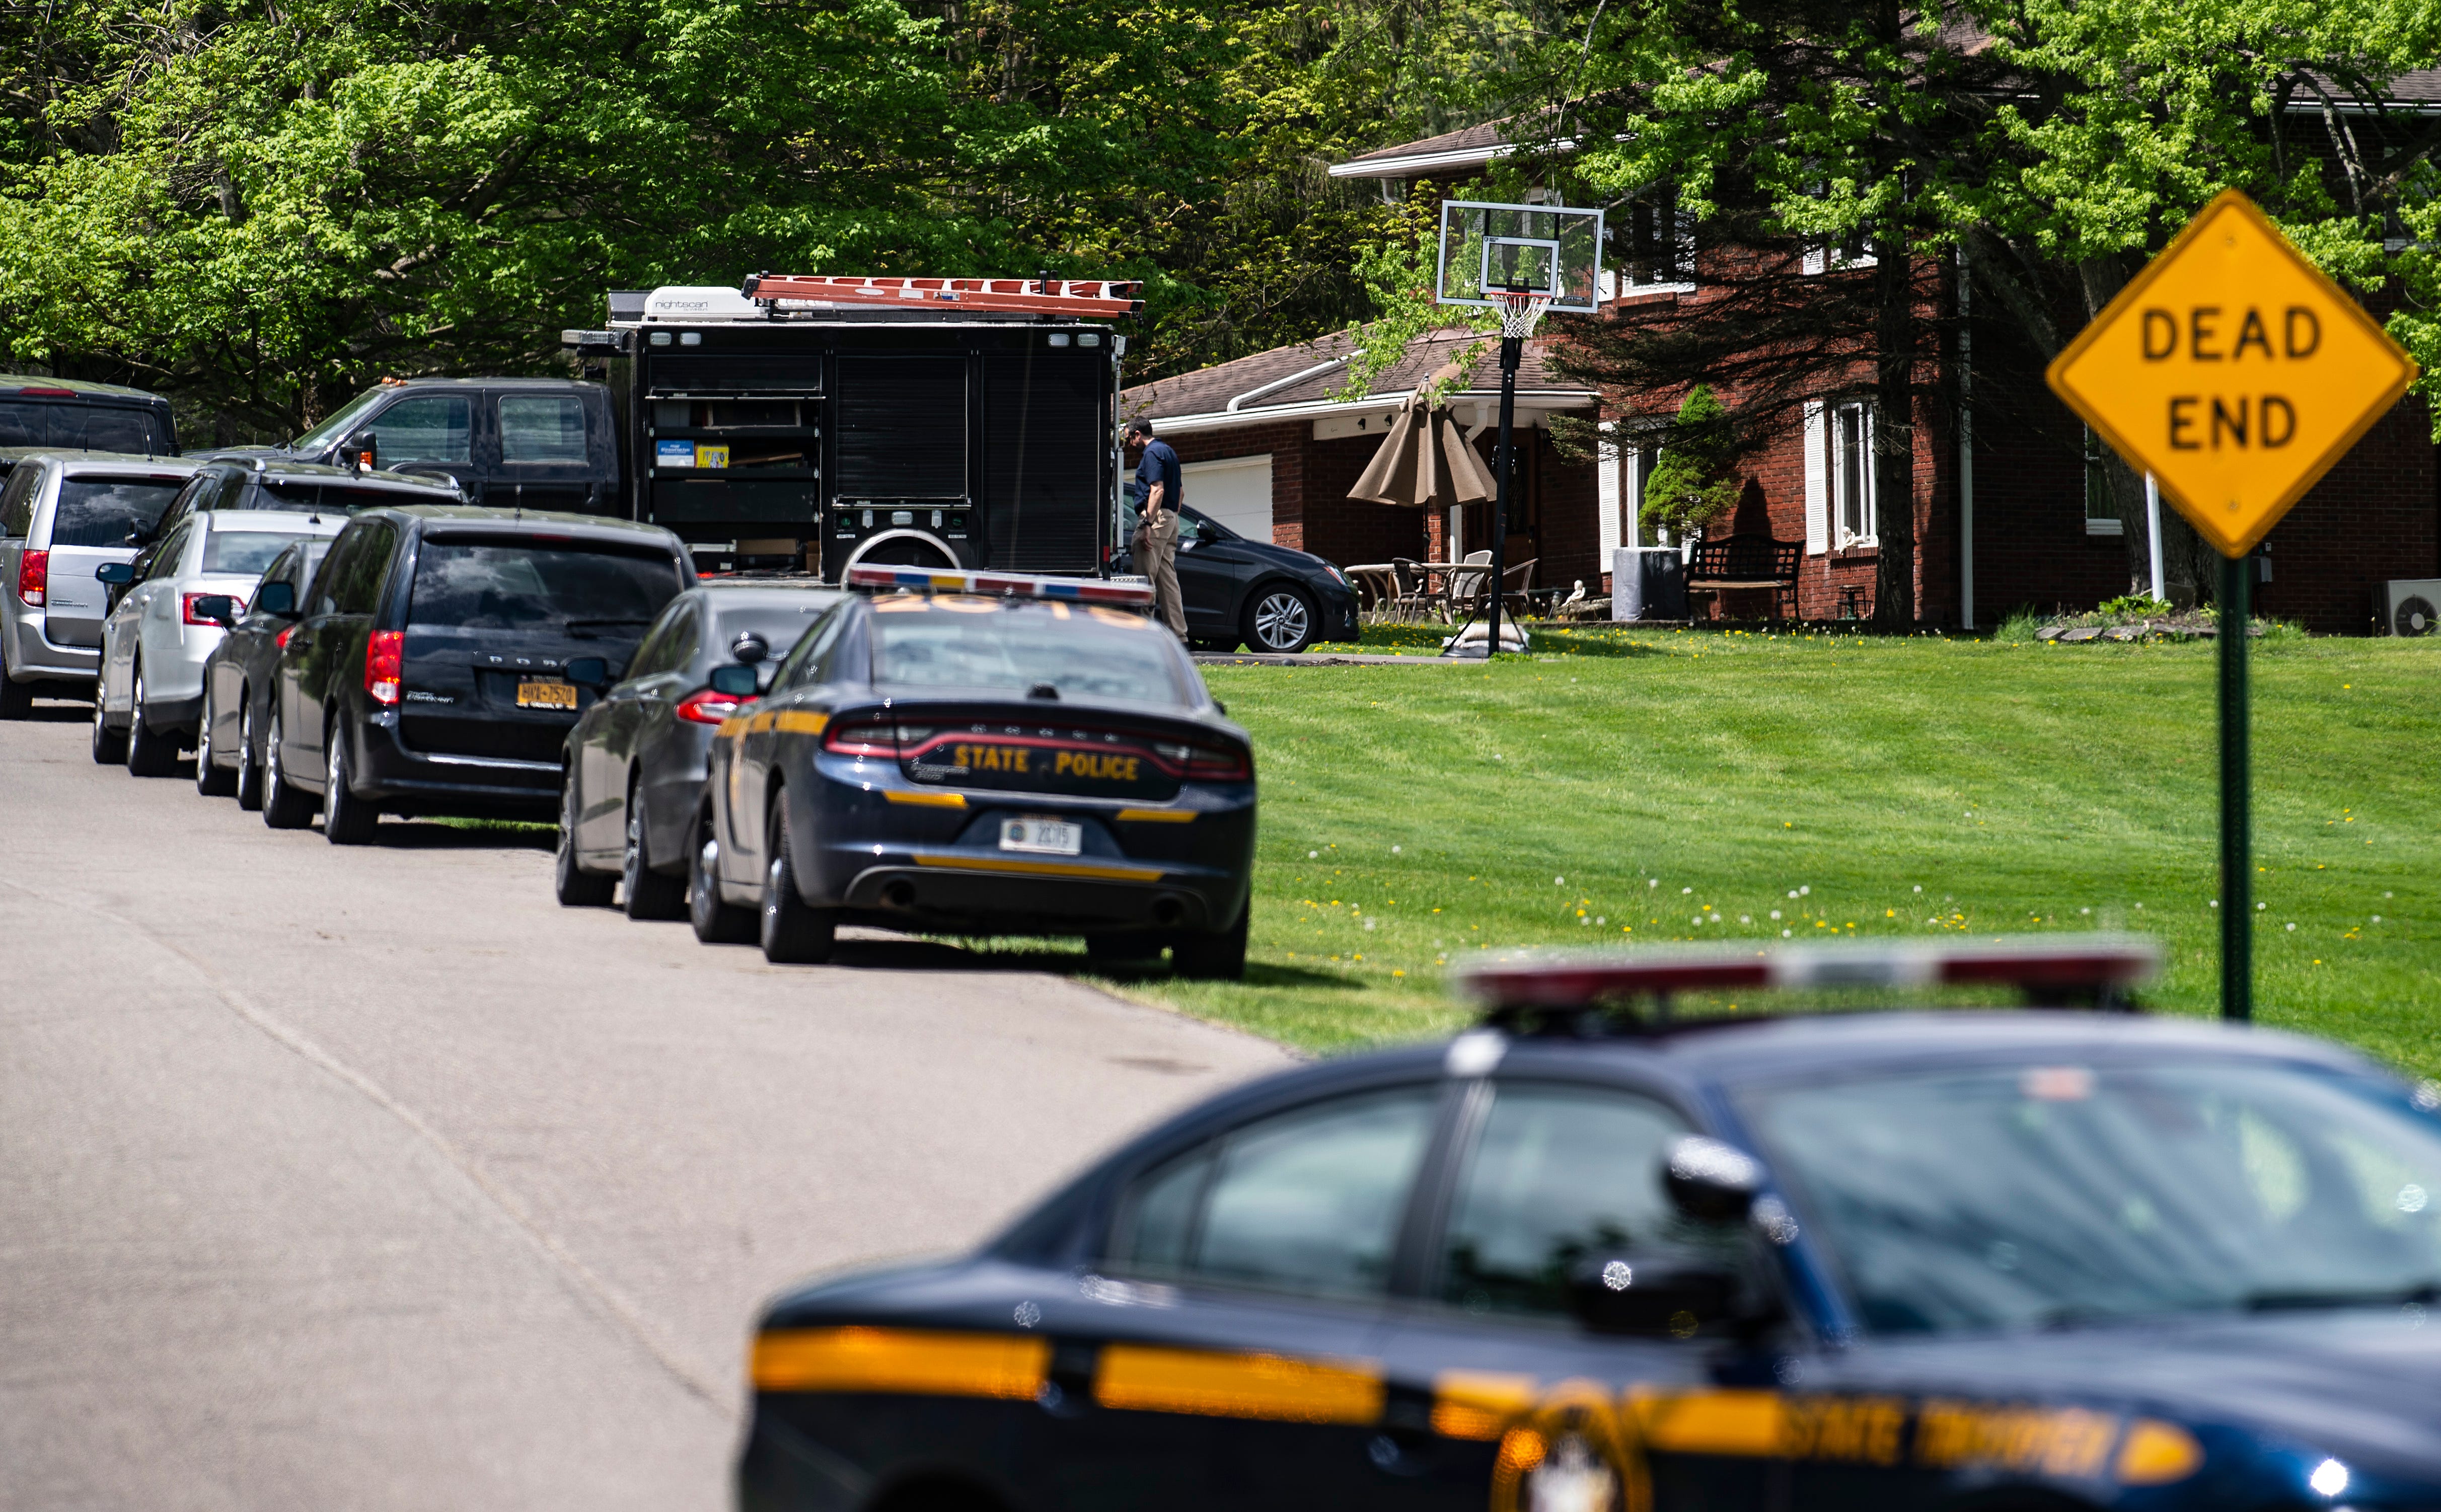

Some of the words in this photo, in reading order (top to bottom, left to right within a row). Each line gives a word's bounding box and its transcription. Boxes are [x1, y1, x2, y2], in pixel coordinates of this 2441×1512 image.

[655, 300, 708, 309] nightscan
[2141, 306, 2324, 363] DEAD
[2168, 394, 2298, 450] END
[955, 745, 1030, 772] STATE
[1056, 751, 1139, 780] POLICE
